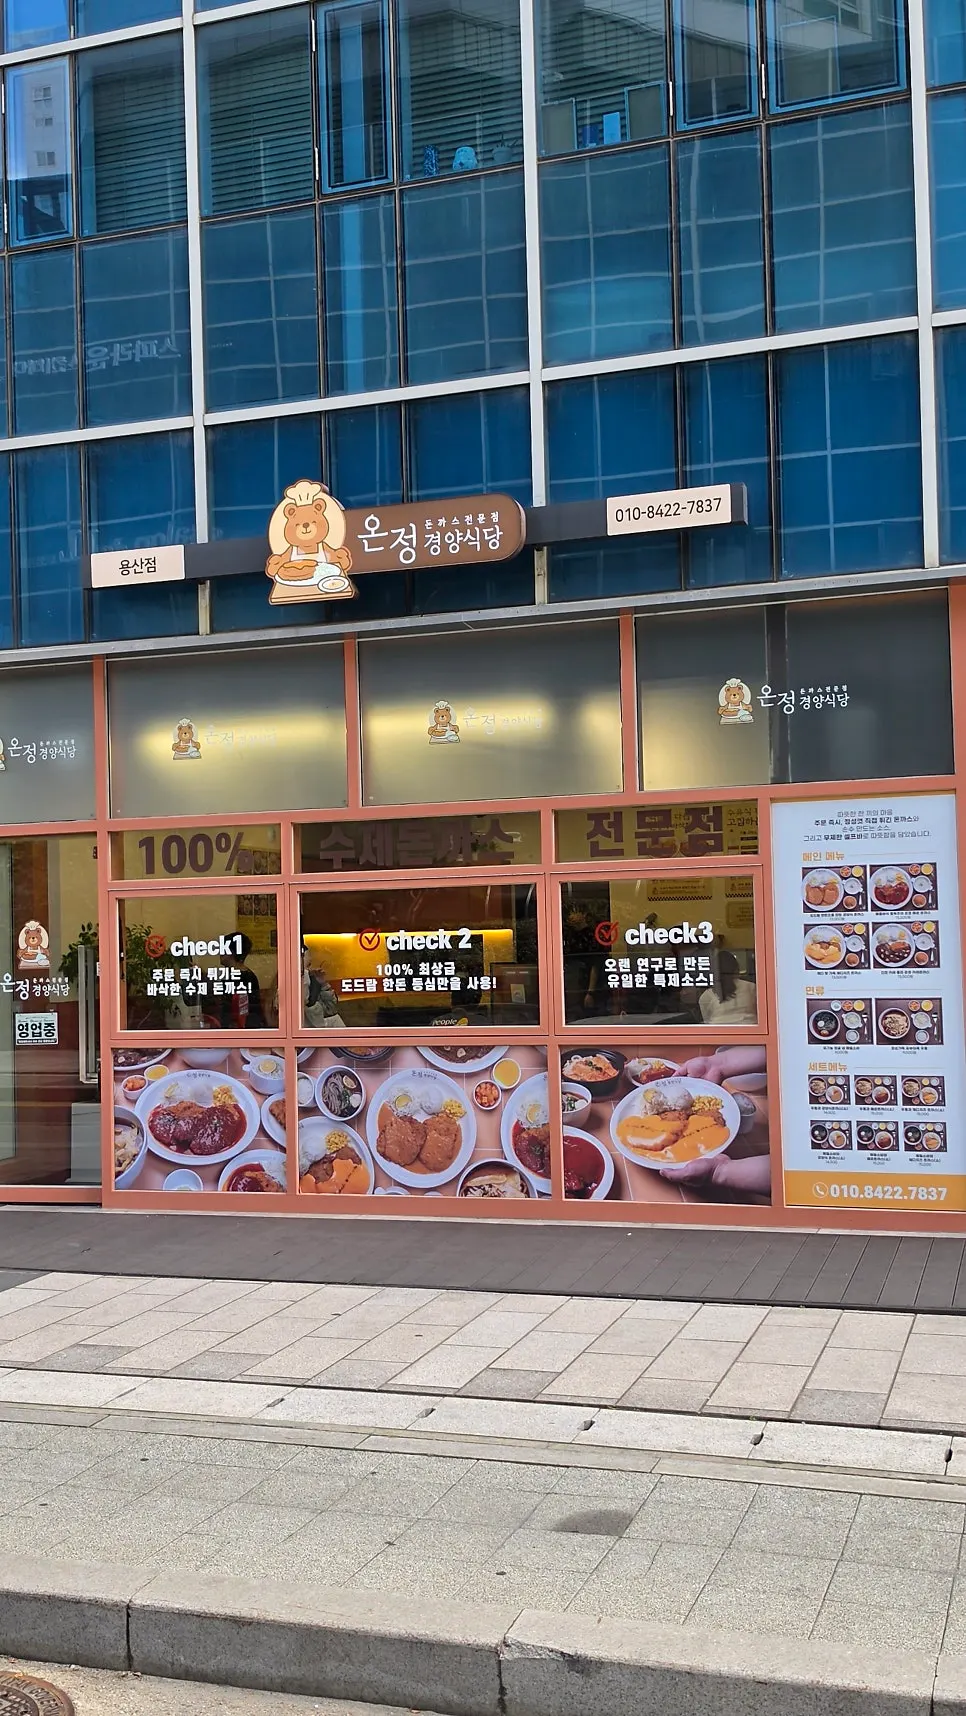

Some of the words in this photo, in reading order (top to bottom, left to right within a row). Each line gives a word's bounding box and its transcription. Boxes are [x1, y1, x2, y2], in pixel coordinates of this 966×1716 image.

[615, 498, 722, 522] 010-8422-7837
[357, 513, 417, 564] 온정
[424, 524, 503, 556] 경양식당
[118, 556, 157, 576] 용산점
[756, 684, 796, 715] 온정
[799, 693, 850, 710] 경양식당
[8, 737, 36, 763] 온정
[40, 746, 76, 760] 경양식당
[138, 831, 254, 875] 100%
[587, 805, 724, 858] 전문점
[802, 851, 822, 862] 메인
[825, 850, 845, 861] 메뉴
[386, 928, 453, 951] check
[458, 927, 472, 949] 2
[625, 921, 714, 945] check3
[170, 934, 243, 957] check1
[376, 963, 414, 976] 100%
[418, 962, 456, 976] 최상급
[636, 957, 678, 972] 연구로
[683, 956, 711, 971] 만든
[152, 968, 175, 982] 주문
[180, 966, 202, 981] 즉시
[207, 966, 242, 981] 튀기는
[607, 974, 648, 989] 유일한
[653, 973, 714, 988] 특제소스!
[0, 972, 30, 1000] 온정
[32, 983, 70, 997] 경양식당
[147, 982, 181, 997] 바삭한
[185, 982, 208, 996] 수제
[213, 981, 252, 995] 돈까스!
[341, 978, 378, 993] 도드람
[382, 978, 407, 992] 한돈
[411, 977, 461, 991] 등심만을
[467, 976, 497, 990] 사용!
[17, 1022, 56, 1038] 영업중
[808, 1062, 848, 1072] 세트메뉴
[830, 1184, 948, 1201] 010.8422.7837
